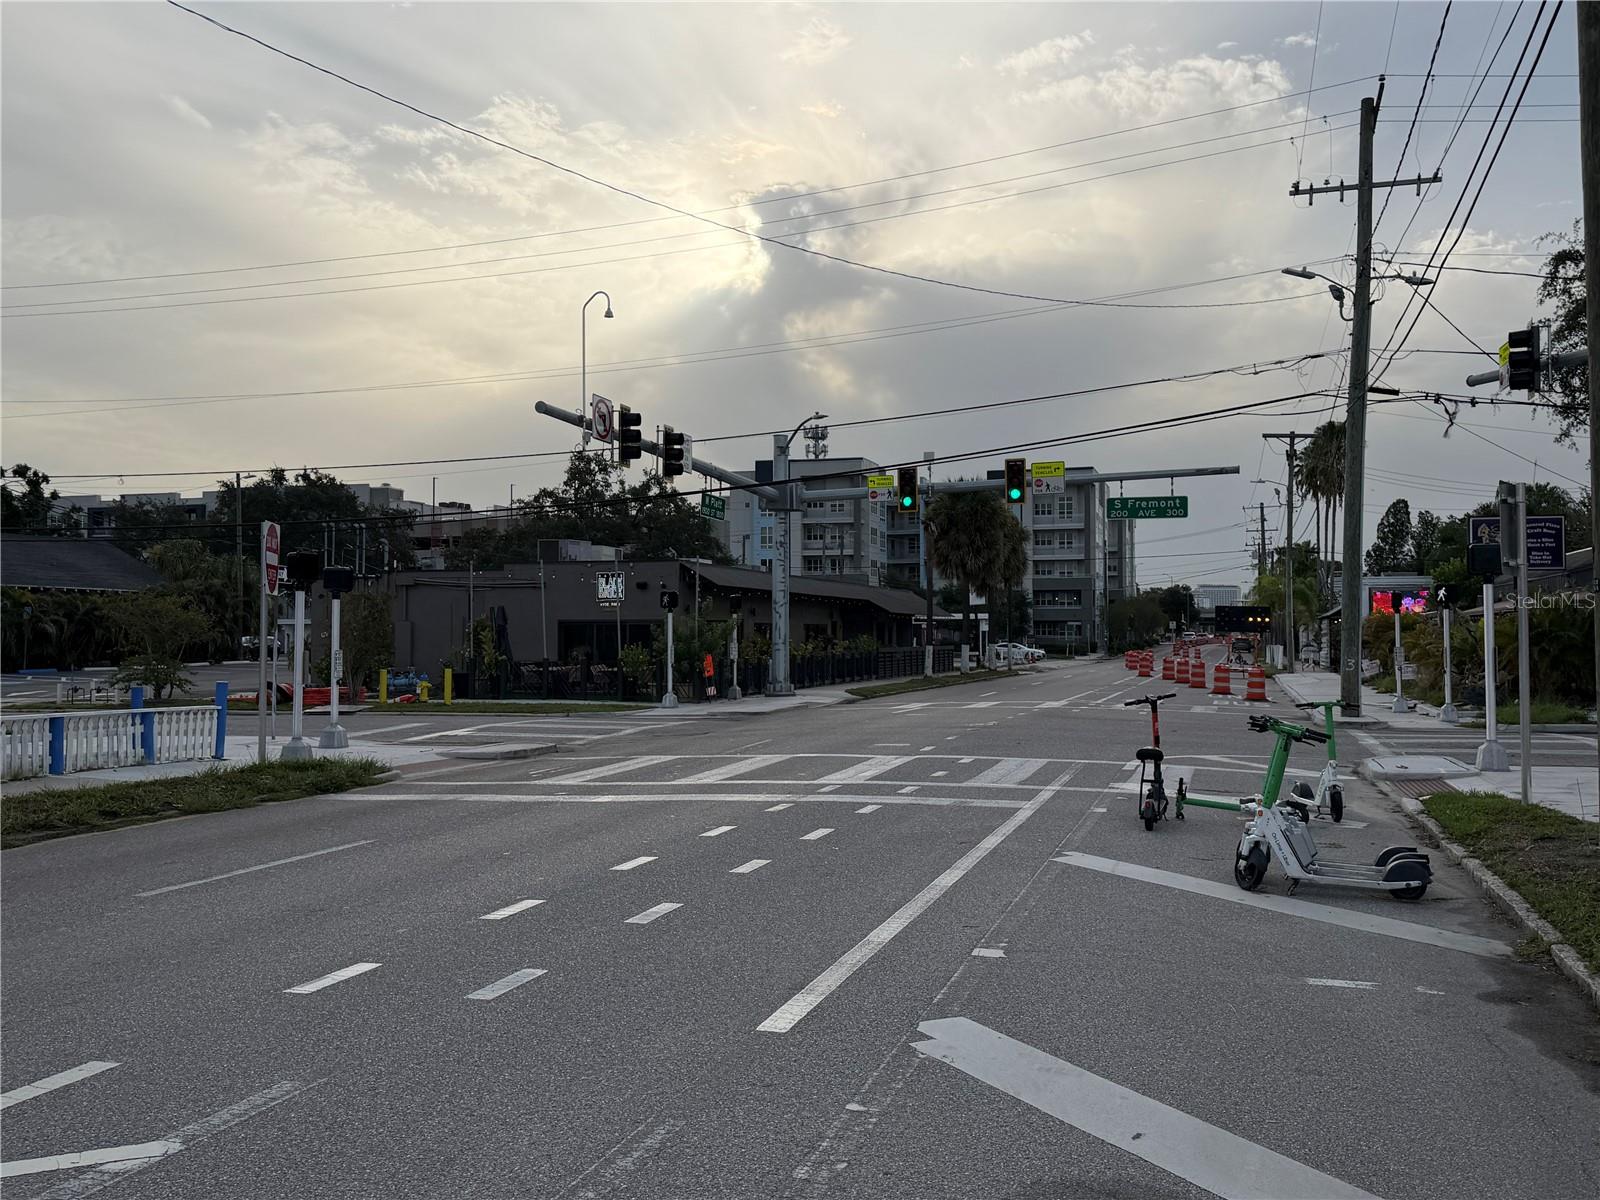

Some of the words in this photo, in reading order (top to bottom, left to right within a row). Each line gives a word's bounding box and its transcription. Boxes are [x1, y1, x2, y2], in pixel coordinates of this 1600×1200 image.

[711, 497, 723, 509] Platt
[1114, 499, 1122, 508] S
[1128, 497, 1181, 508] Fremont
[1110, 510, 1128, 518] 200
[1137, 509, 1157, 517] AVE
[1166, 508, 1185, 516] 300
[1345, 659, 1356, 671] 3
